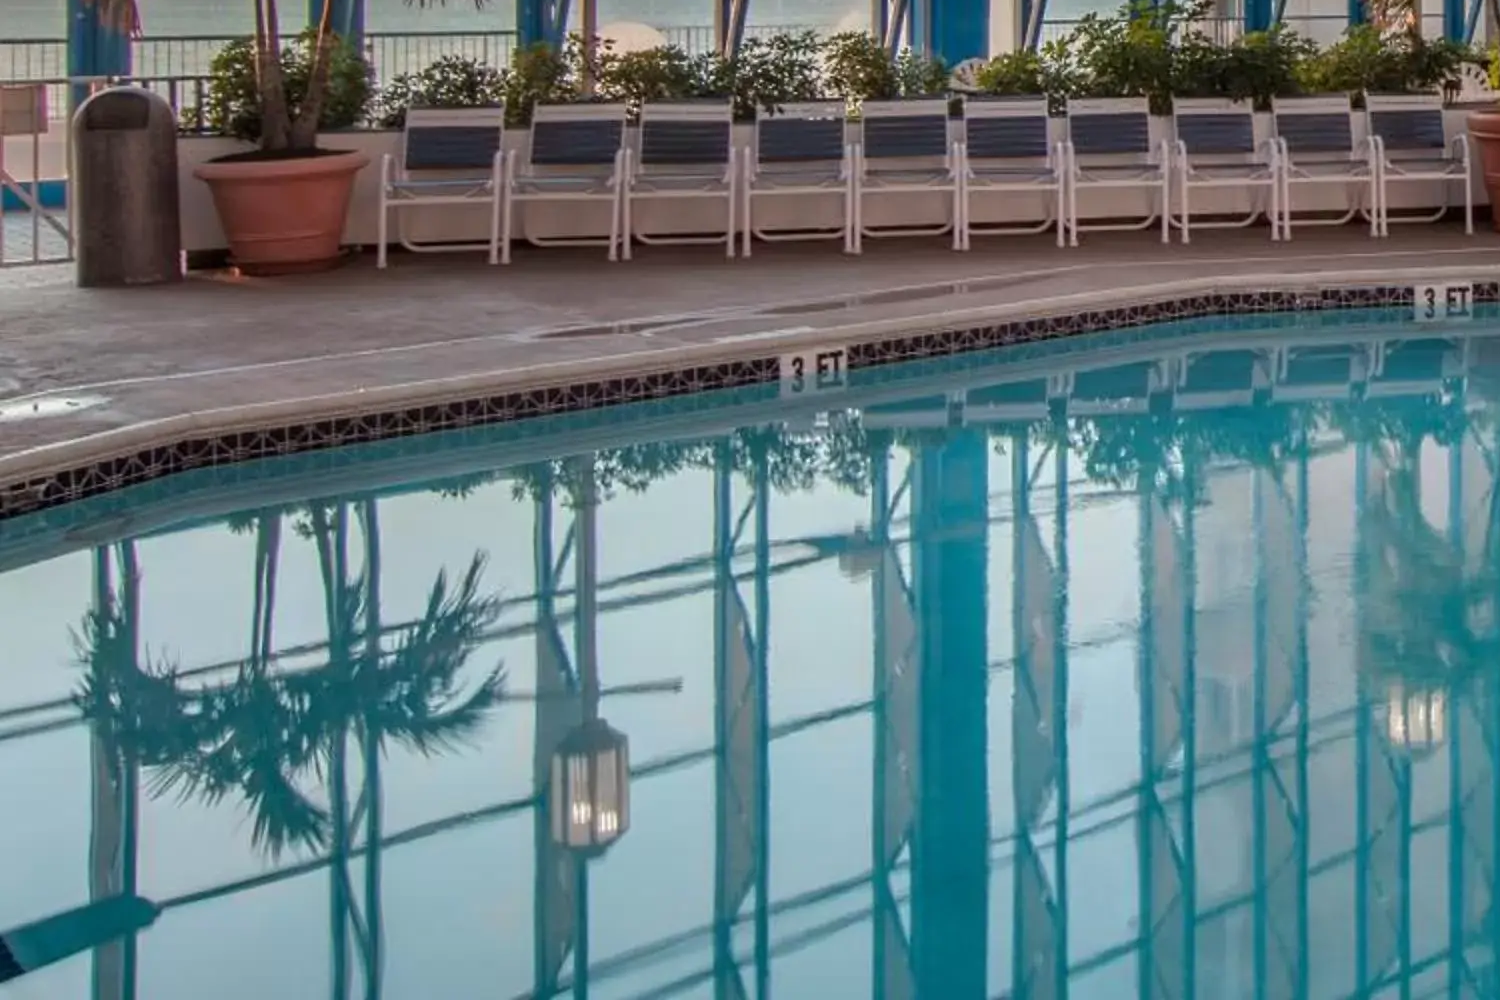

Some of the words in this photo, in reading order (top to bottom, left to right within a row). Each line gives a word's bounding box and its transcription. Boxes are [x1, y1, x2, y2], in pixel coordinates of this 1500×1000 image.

[1424, 287, 1436, 310] 3
[1446, 286, 1470, 309] FT
[791, 356, 804, 381] 3
[816, 349, 843, 378] FT
